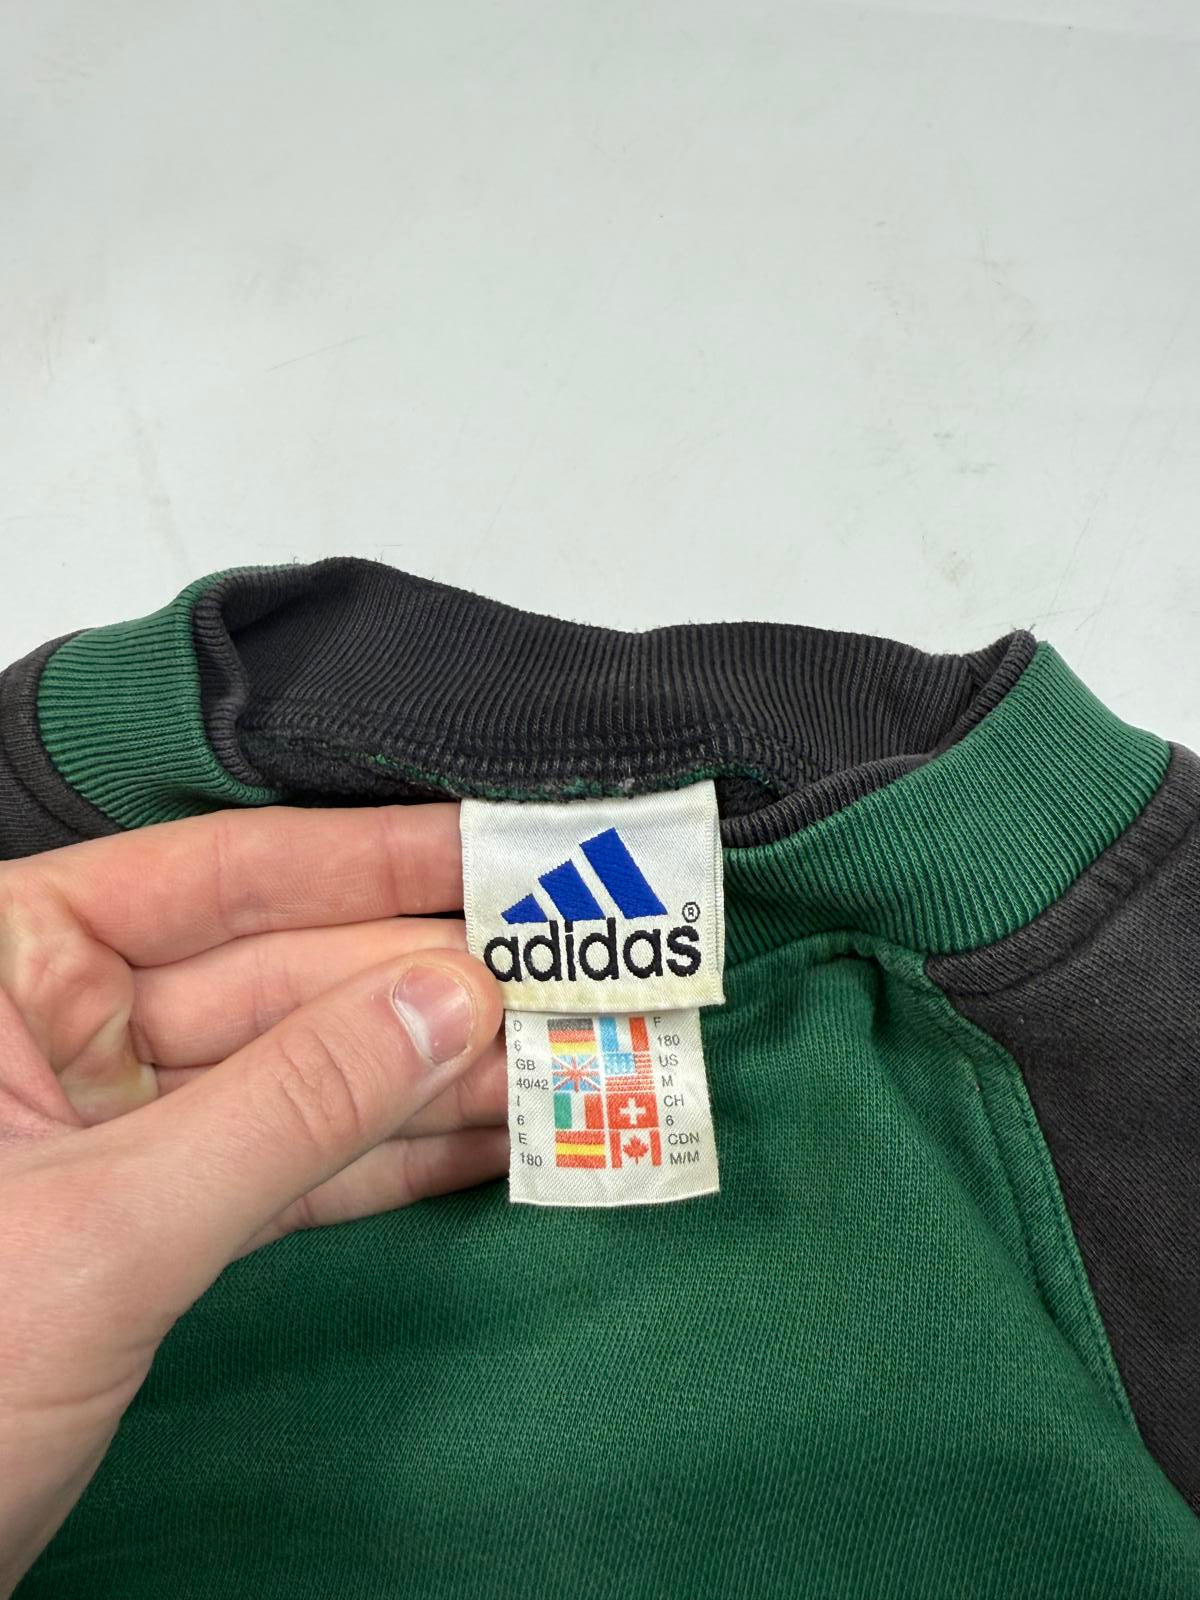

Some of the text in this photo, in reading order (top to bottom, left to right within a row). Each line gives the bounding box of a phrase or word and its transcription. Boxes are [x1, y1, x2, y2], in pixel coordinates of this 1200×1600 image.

[484, 917, 701, 982] adidas
[513, 1020, 522, 1032] D
[653, 1017, 662, 1027] F
[657, 1034, 680, 1047] 180
[515, 1059, 536, 1070] GB
[658, 1055, 679, 1067] US
[516, 1078, 549, 1090] 40/42
[661, 1075, 674, 1088] M
[663, 1095, 684, 1107] CH
[517, 1115, 525, 1126] 6
[665, 1115, 674, 1126] 6
[518, 1133, 527, 1145] E
[668, 1132, 700, 1145] CDN
[519, 1152, 543, 1167] 180
[669, 1151, 700, 1165] M/M
